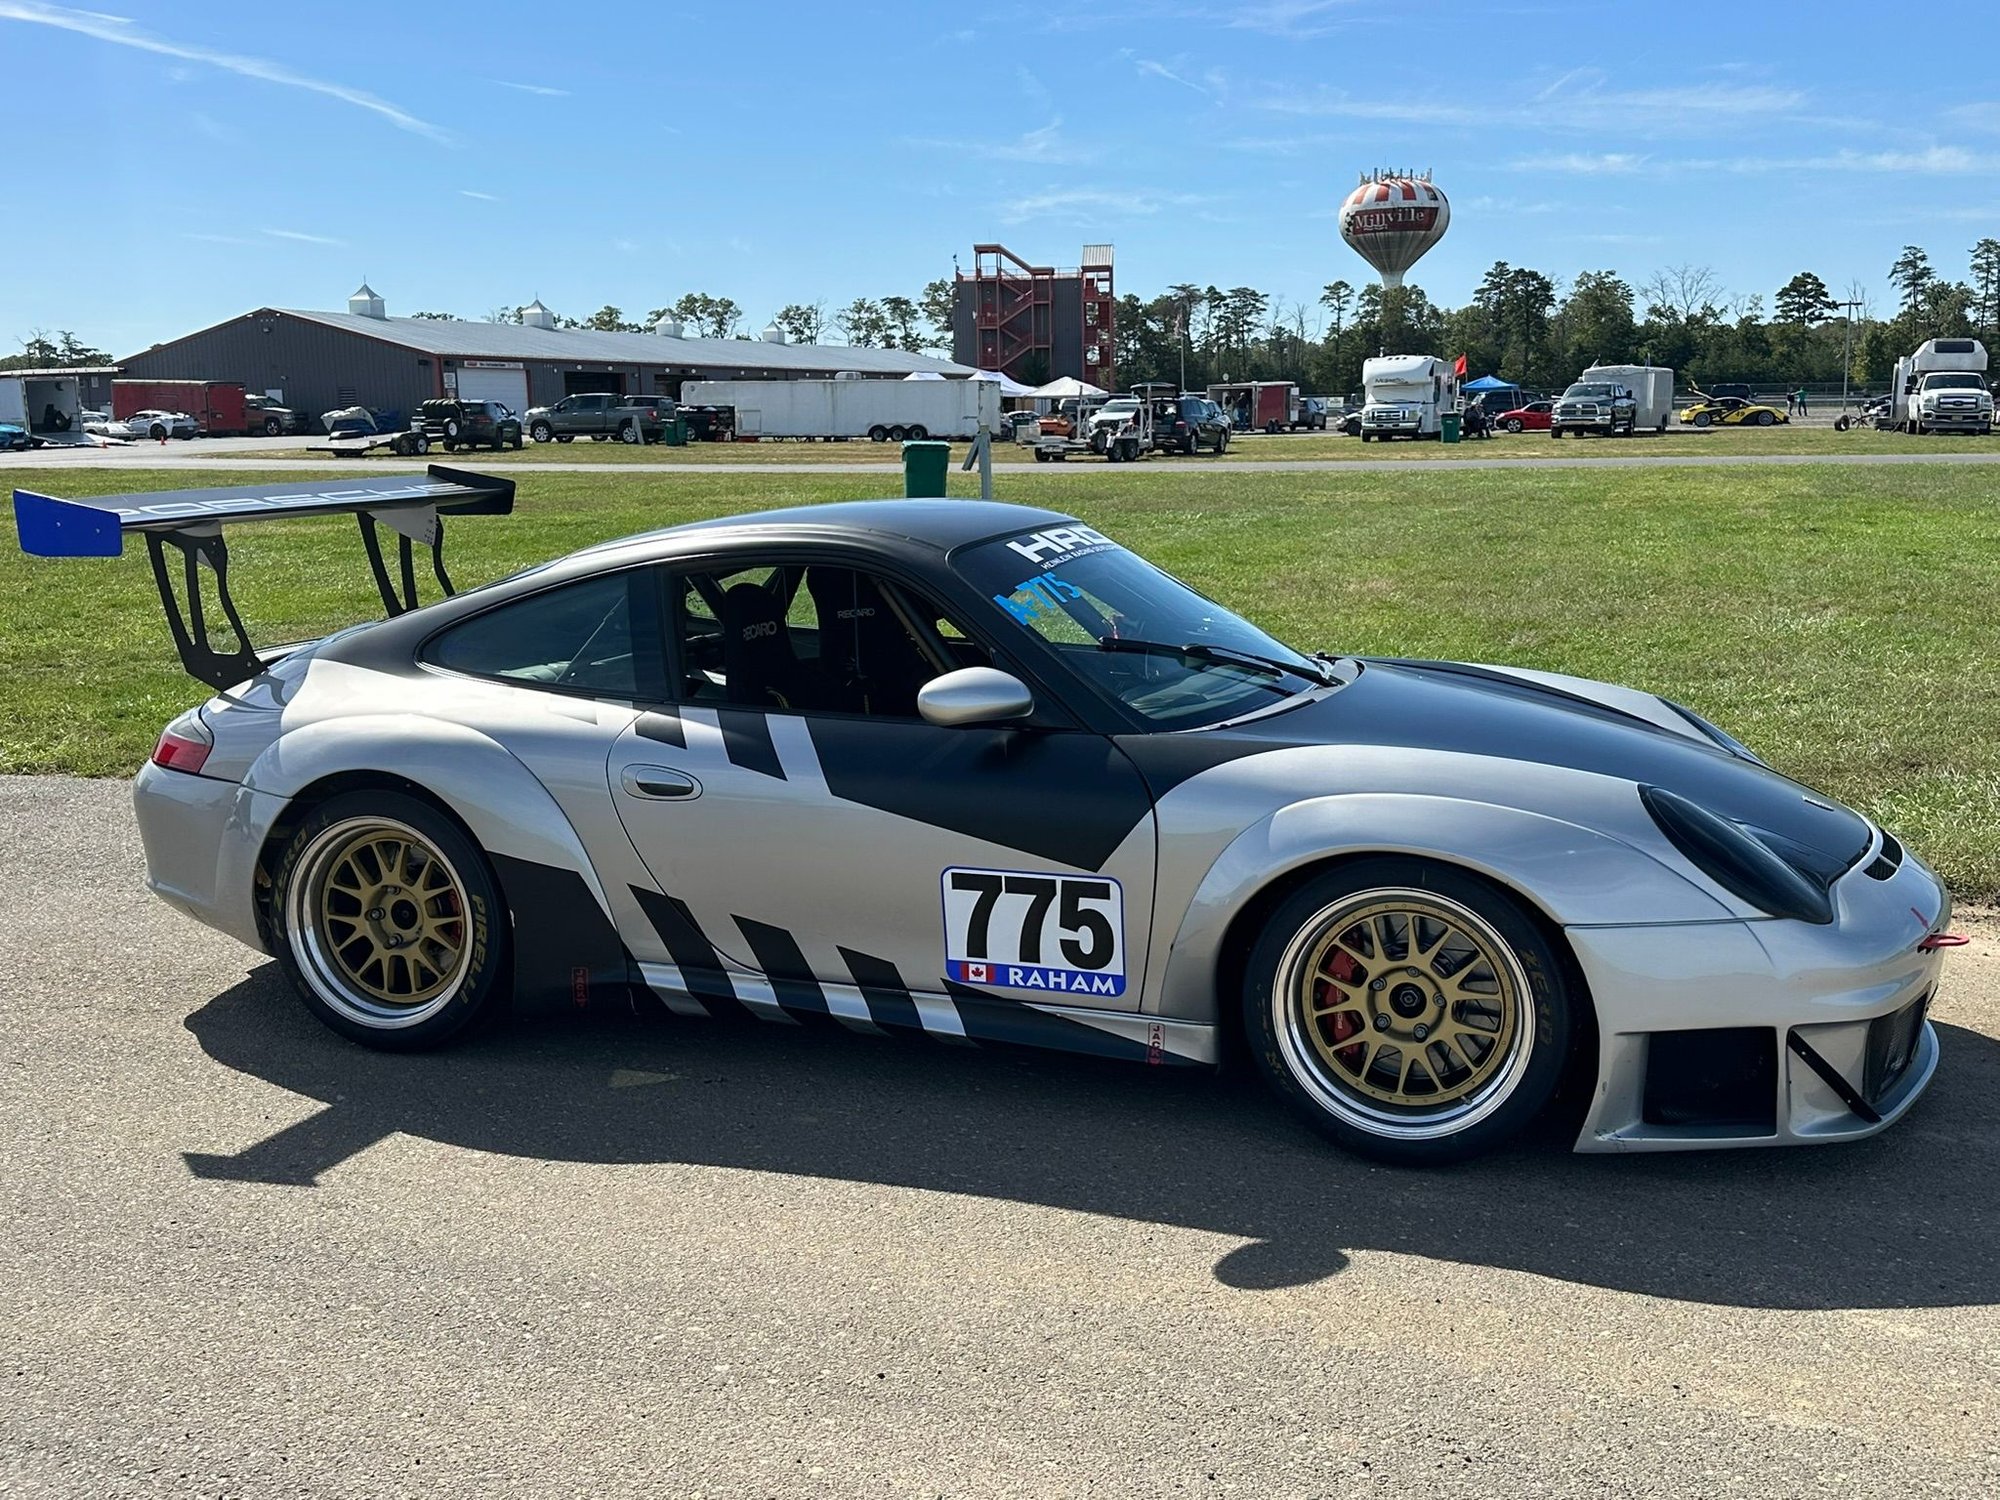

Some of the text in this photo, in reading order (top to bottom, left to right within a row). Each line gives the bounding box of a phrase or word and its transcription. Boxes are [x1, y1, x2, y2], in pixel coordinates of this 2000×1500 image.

[1355, 208, 1424, 229] Millville
[837, 607, 875, 619] RECARO
[742, 620, 778, 641] RECARO
[951, 872, 1114, 970] 775
[459, 894, 488, 1004] PIRELLI
[1008, 967, 1116, 994] RAHAM
[1151, 1025, 1161, 1057] JACK
